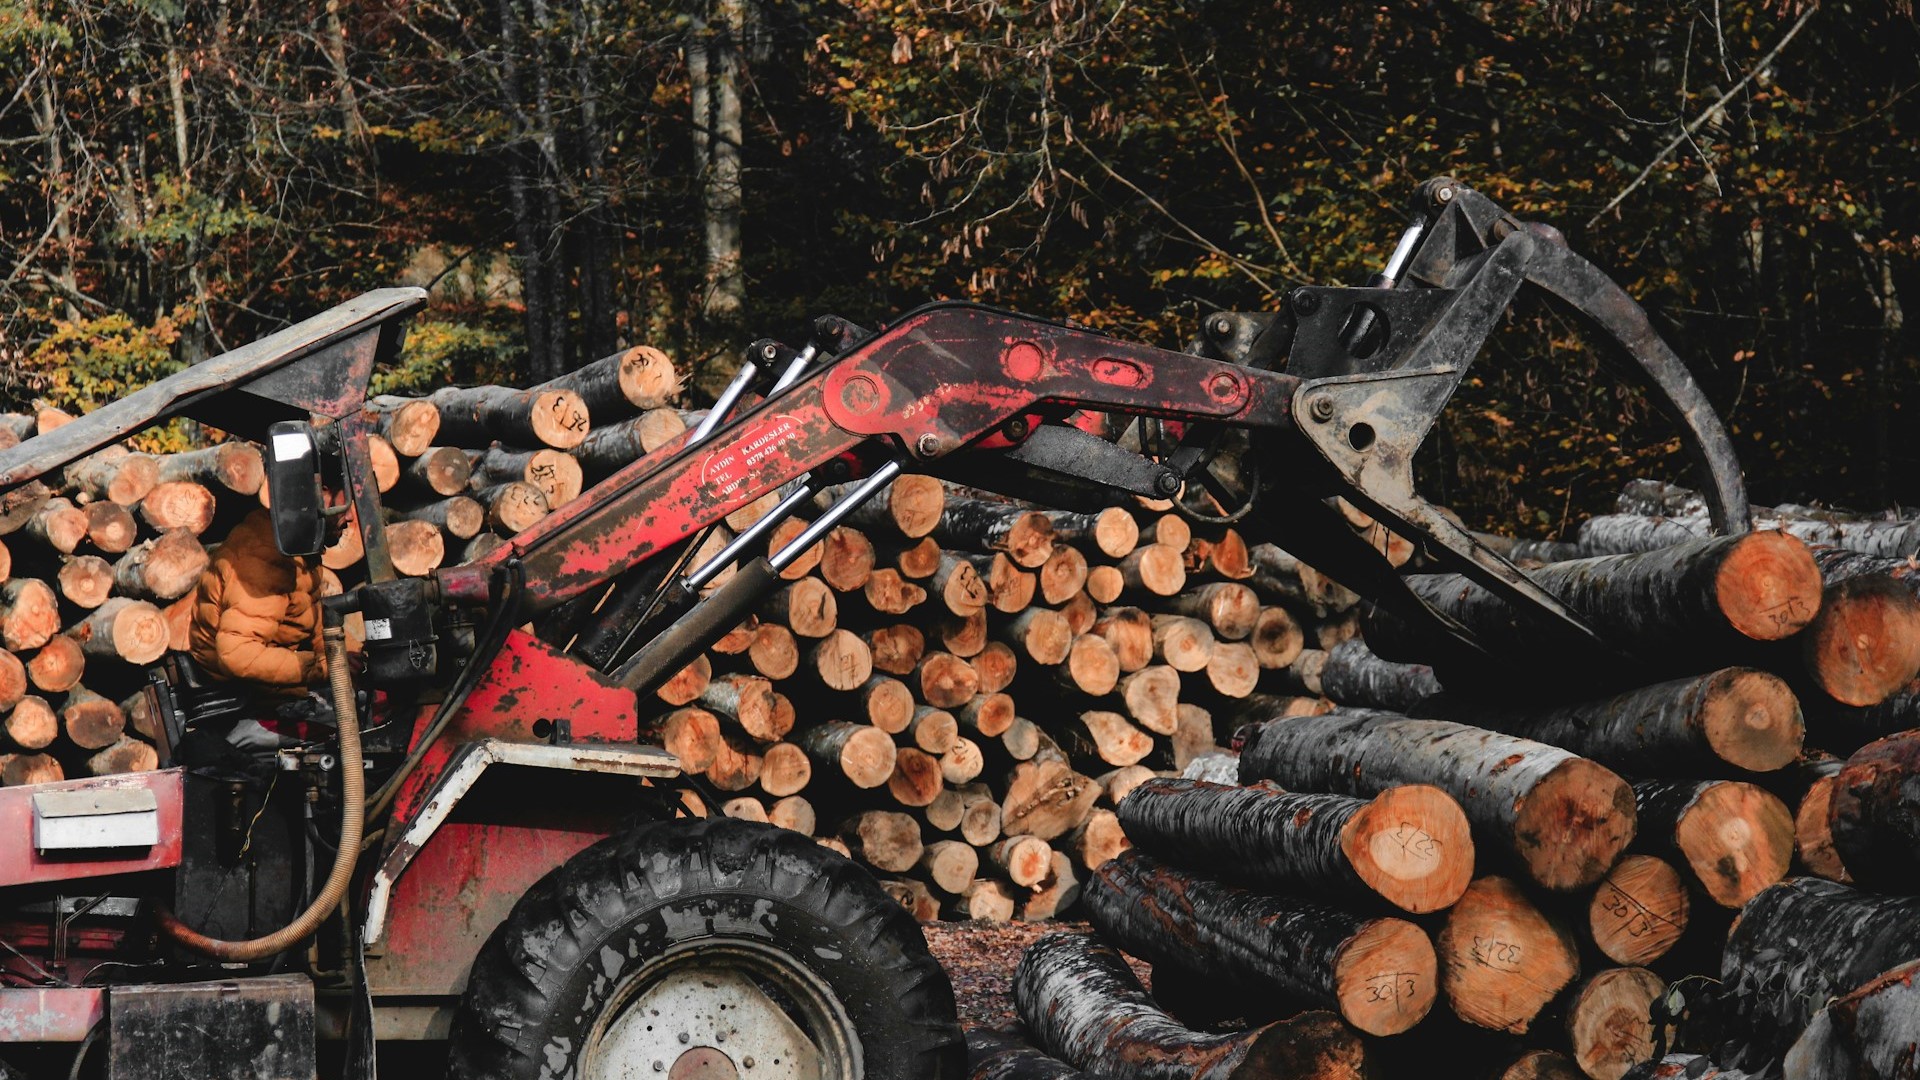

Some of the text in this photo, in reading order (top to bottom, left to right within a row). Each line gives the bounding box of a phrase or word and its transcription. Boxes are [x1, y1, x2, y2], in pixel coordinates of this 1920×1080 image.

[710, 455, 735, 475] AYDIN
[714, 472, 732, 485] TEL
[764, 444, 777, 456] 426
